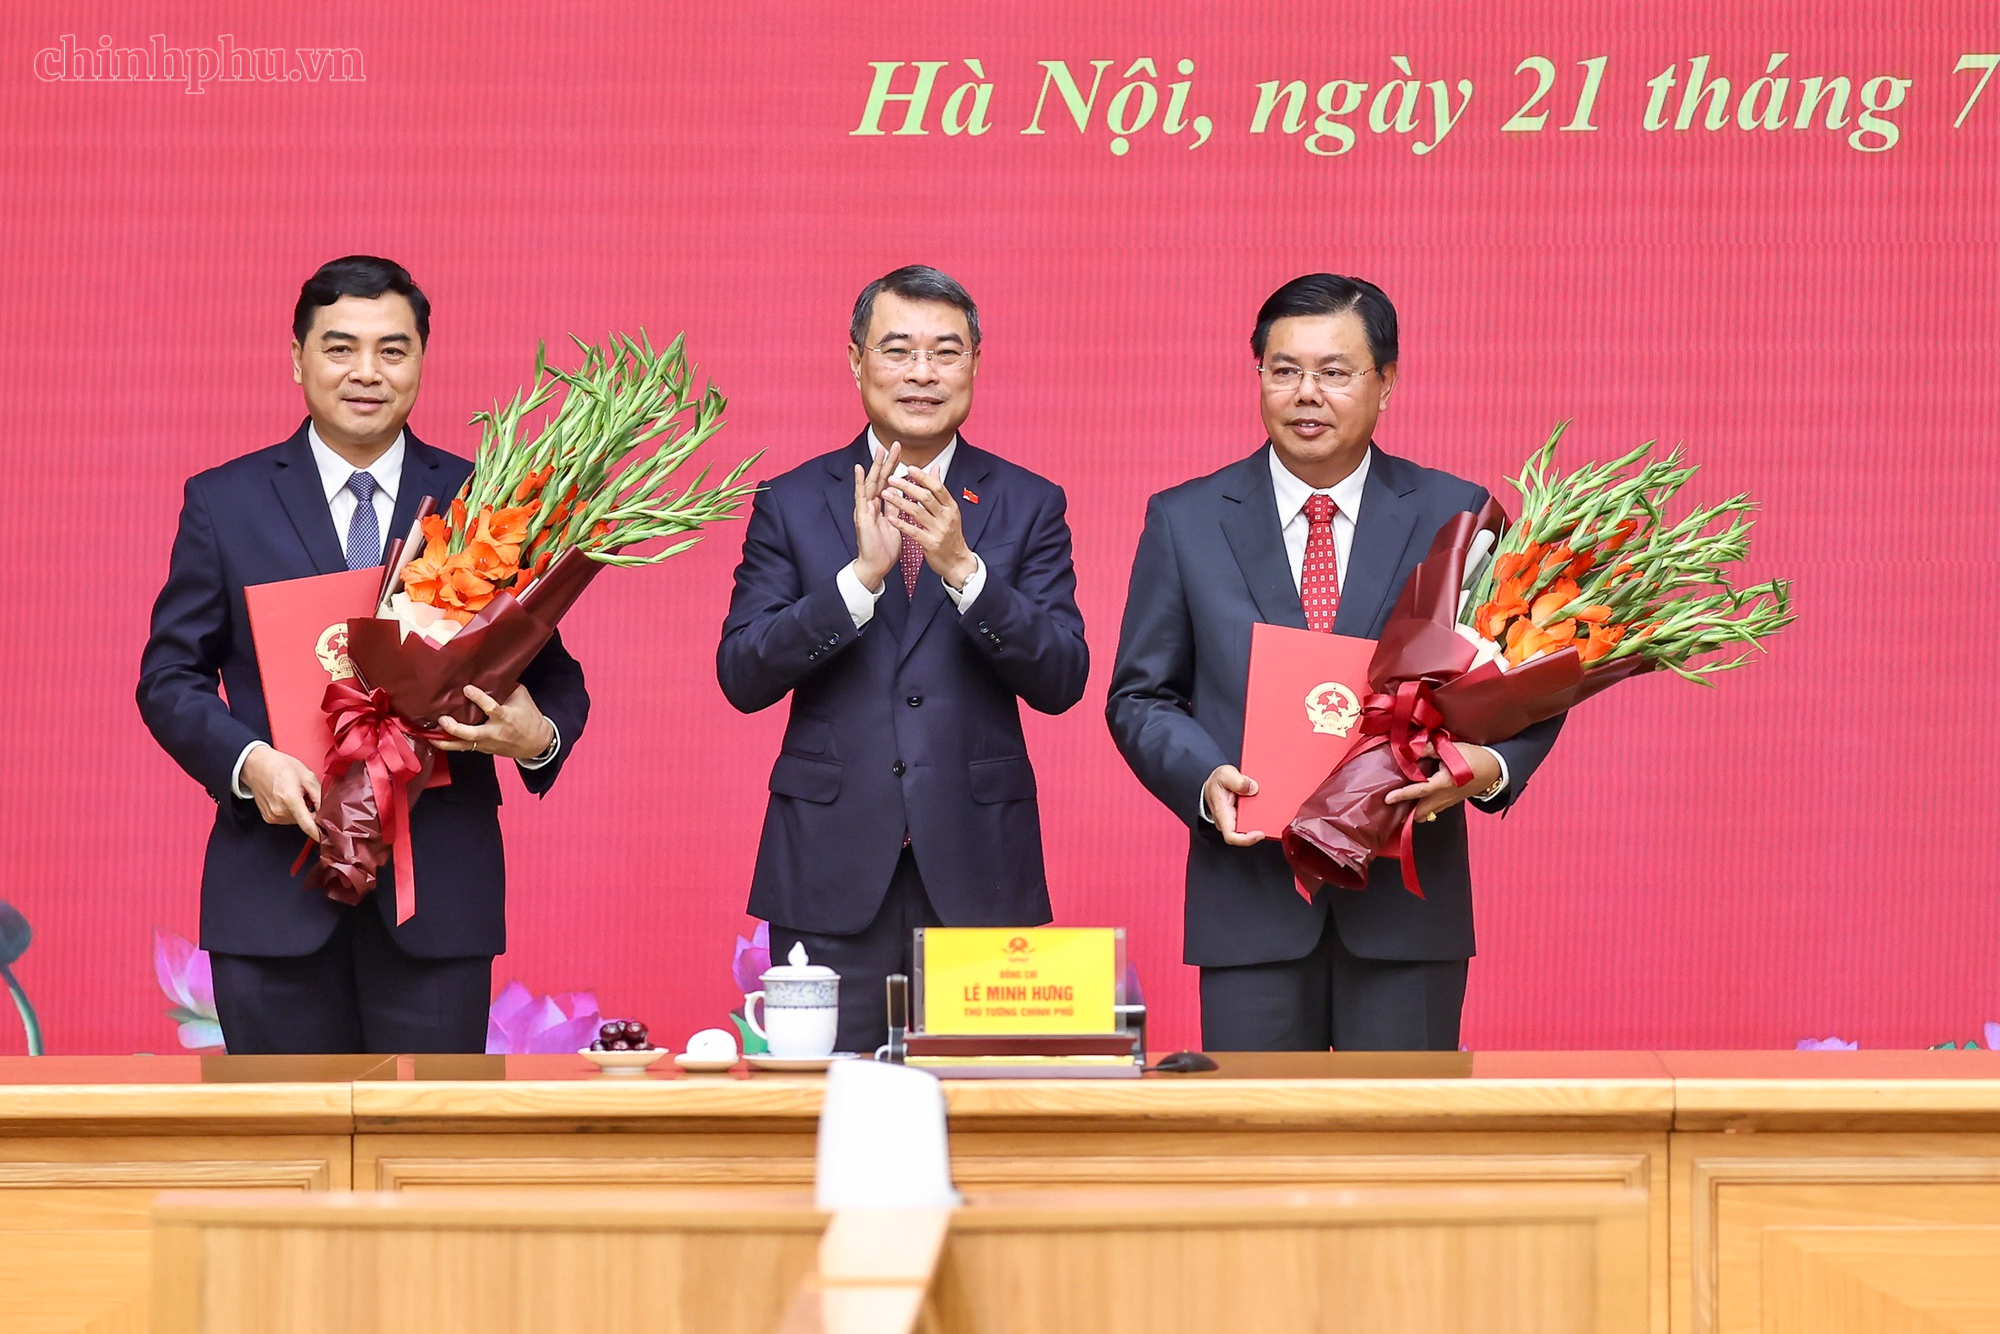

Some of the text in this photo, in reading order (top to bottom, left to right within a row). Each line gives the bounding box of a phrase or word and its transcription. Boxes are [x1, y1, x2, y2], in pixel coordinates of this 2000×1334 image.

[849, 52, 2000, 156] Hà Nội, ngày 21 tháng 7
[964, 982, 1074, 1001] LÊ MINH HƯNG
